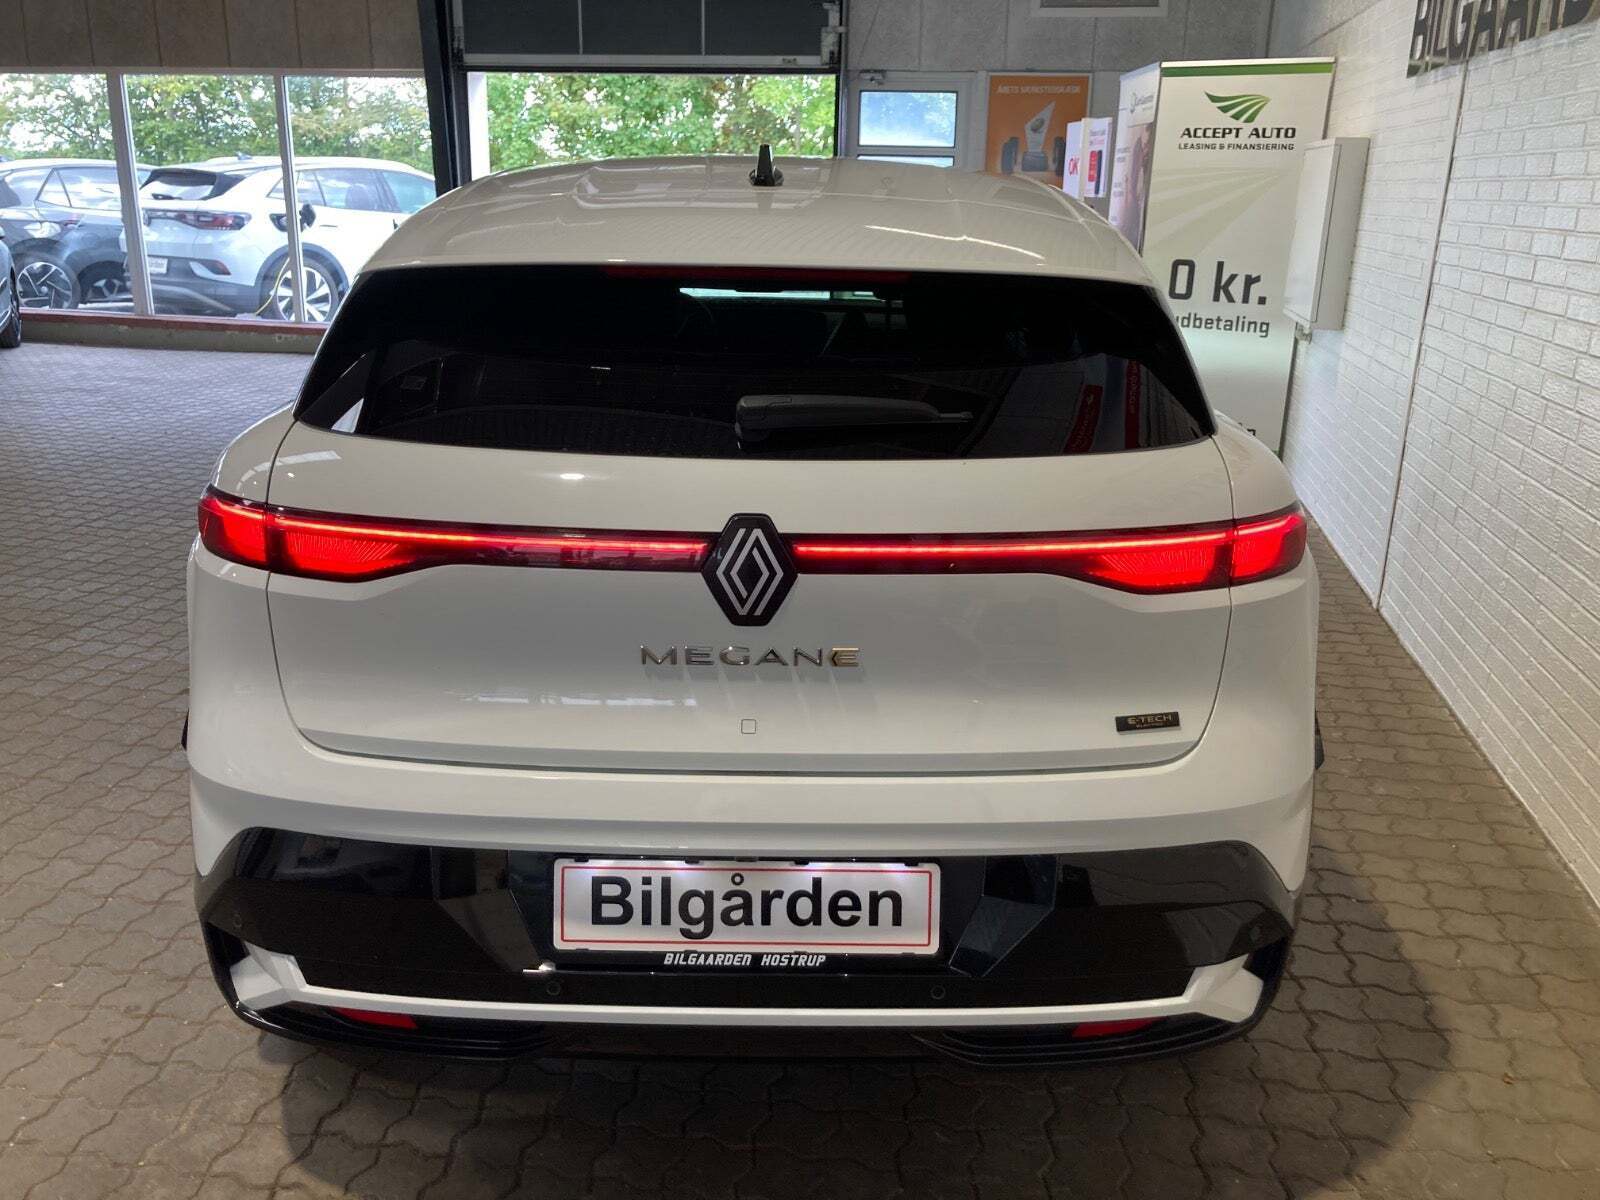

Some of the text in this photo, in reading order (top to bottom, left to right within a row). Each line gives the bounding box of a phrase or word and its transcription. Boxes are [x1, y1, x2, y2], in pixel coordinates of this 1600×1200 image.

[1180, 127, 1297, 139] ACCEPT AUTO
[1178, 142, 1217, 150] LEASING
[1227, 143, 1295, 151] FINANSIERING
[1212, 260, 1268, 306] kr.
[640, 645, 860, 668] MEGANE
[591, 873, 902, 940] Bilgården
[664, 953, 826, 967] BILGAARDEN HOSTRUP
